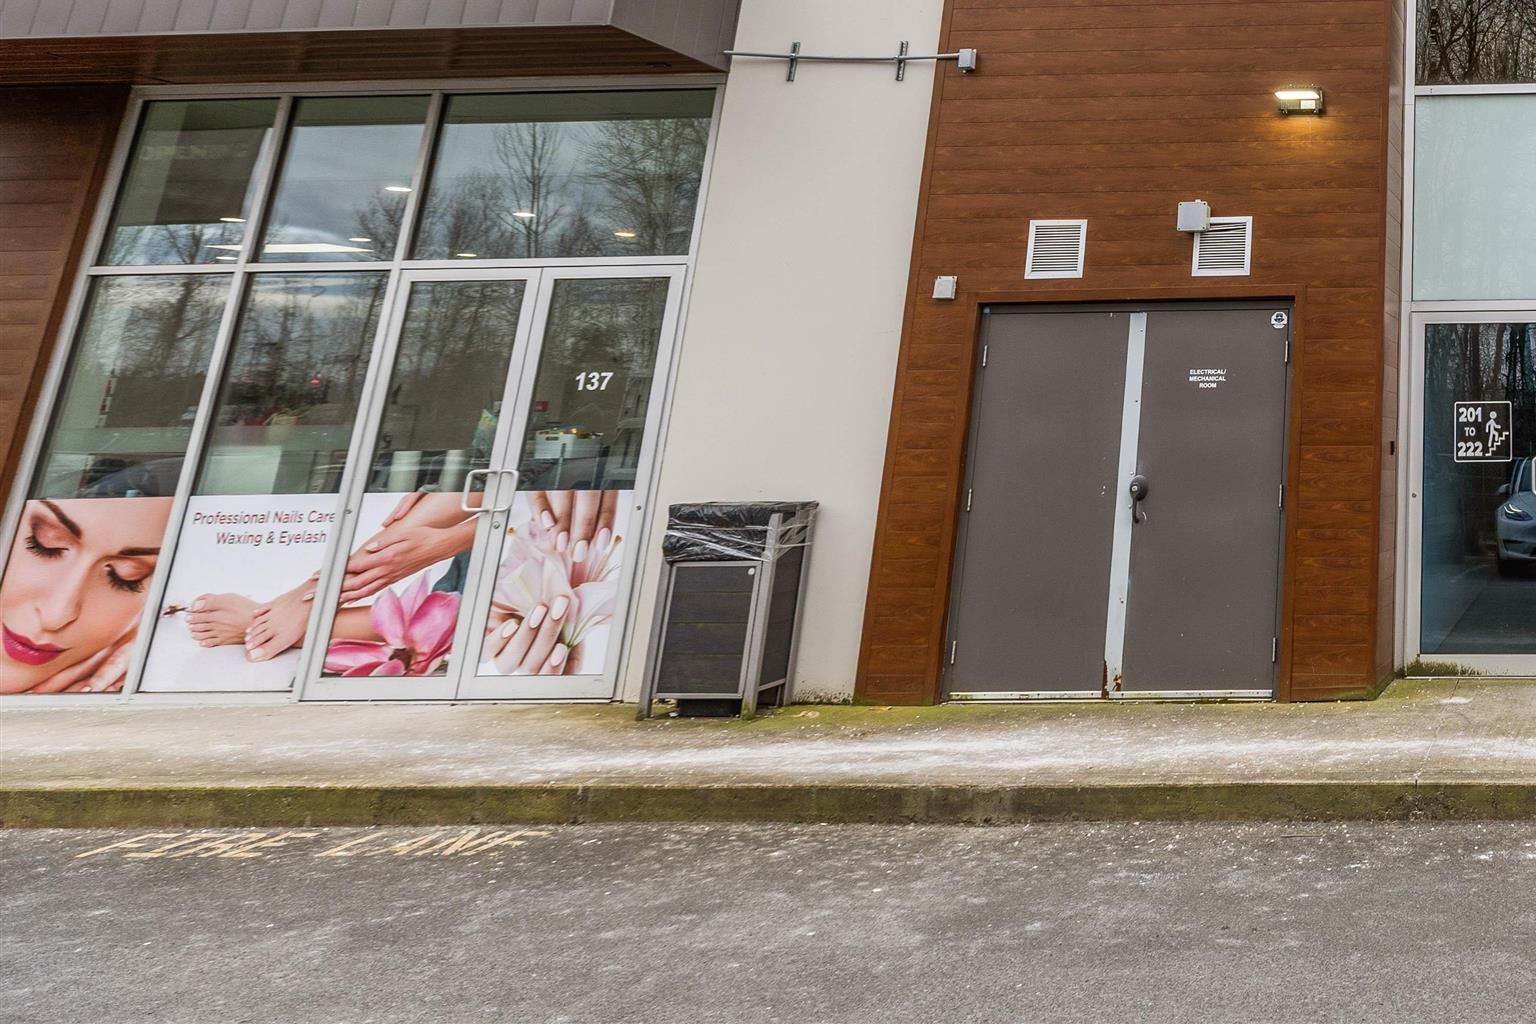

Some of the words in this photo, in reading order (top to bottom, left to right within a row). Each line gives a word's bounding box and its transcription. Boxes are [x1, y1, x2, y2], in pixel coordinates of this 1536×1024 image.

[575, 371, 614, 391] 137
[1458, 407, 1482, 422] 201
[1464, 427, 1476, 437] TO
[1457, 441, 1483, 457] 222
[192, 511, 269, 525] Professional
[273, 510, 303, 524] Nails
[307, 510, 336, 523] Care
[216, 531, 262, 547] Waxing
[266, 530, 275, 544] &
[279, 530, 327, 546] Eyelash
